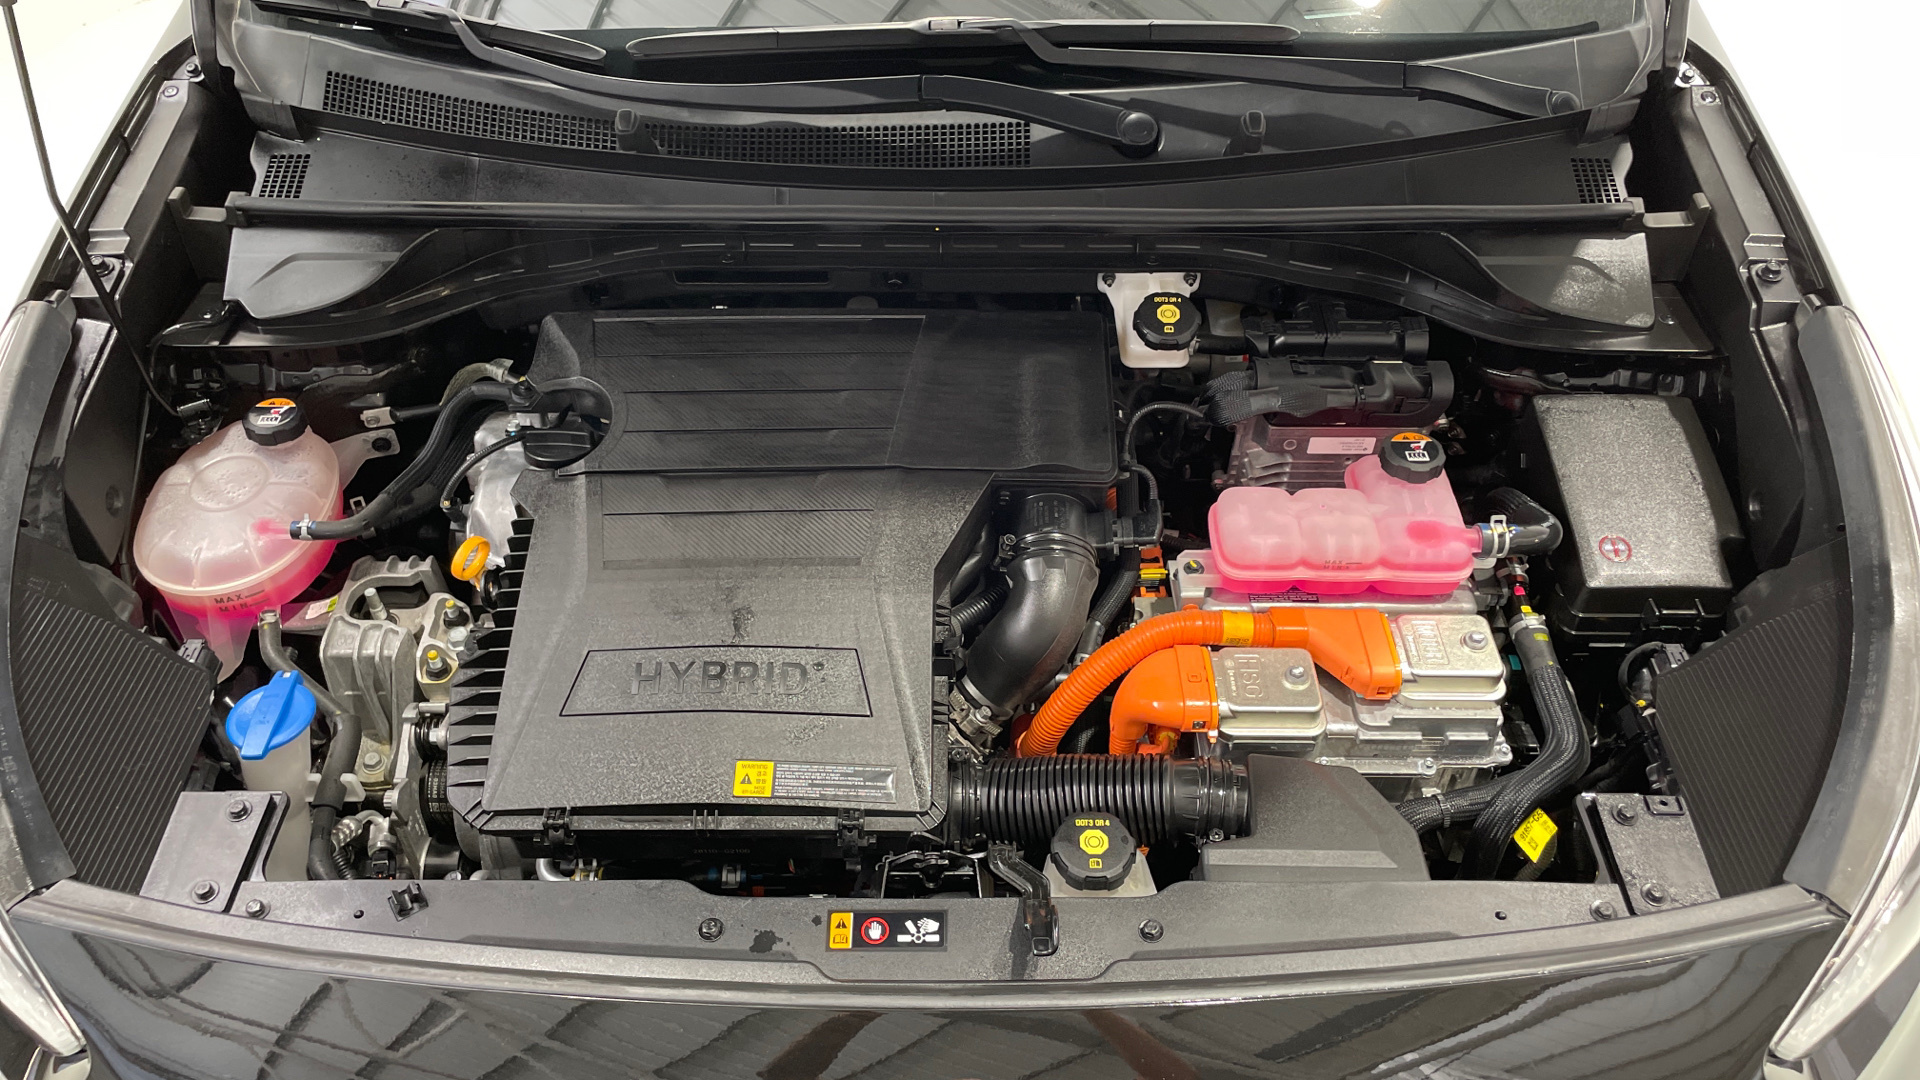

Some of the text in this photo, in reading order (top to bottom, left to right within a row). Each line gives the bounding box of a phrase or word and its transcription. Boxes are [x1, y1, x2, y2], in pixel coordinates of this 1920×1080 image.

[214, 593, 244, 604] MAX
[218, 602, 249, 612] MIN
[630, 660, 809, 696] HYBRID
[1075, 819, 1110, 827] DOT3 OR 4
